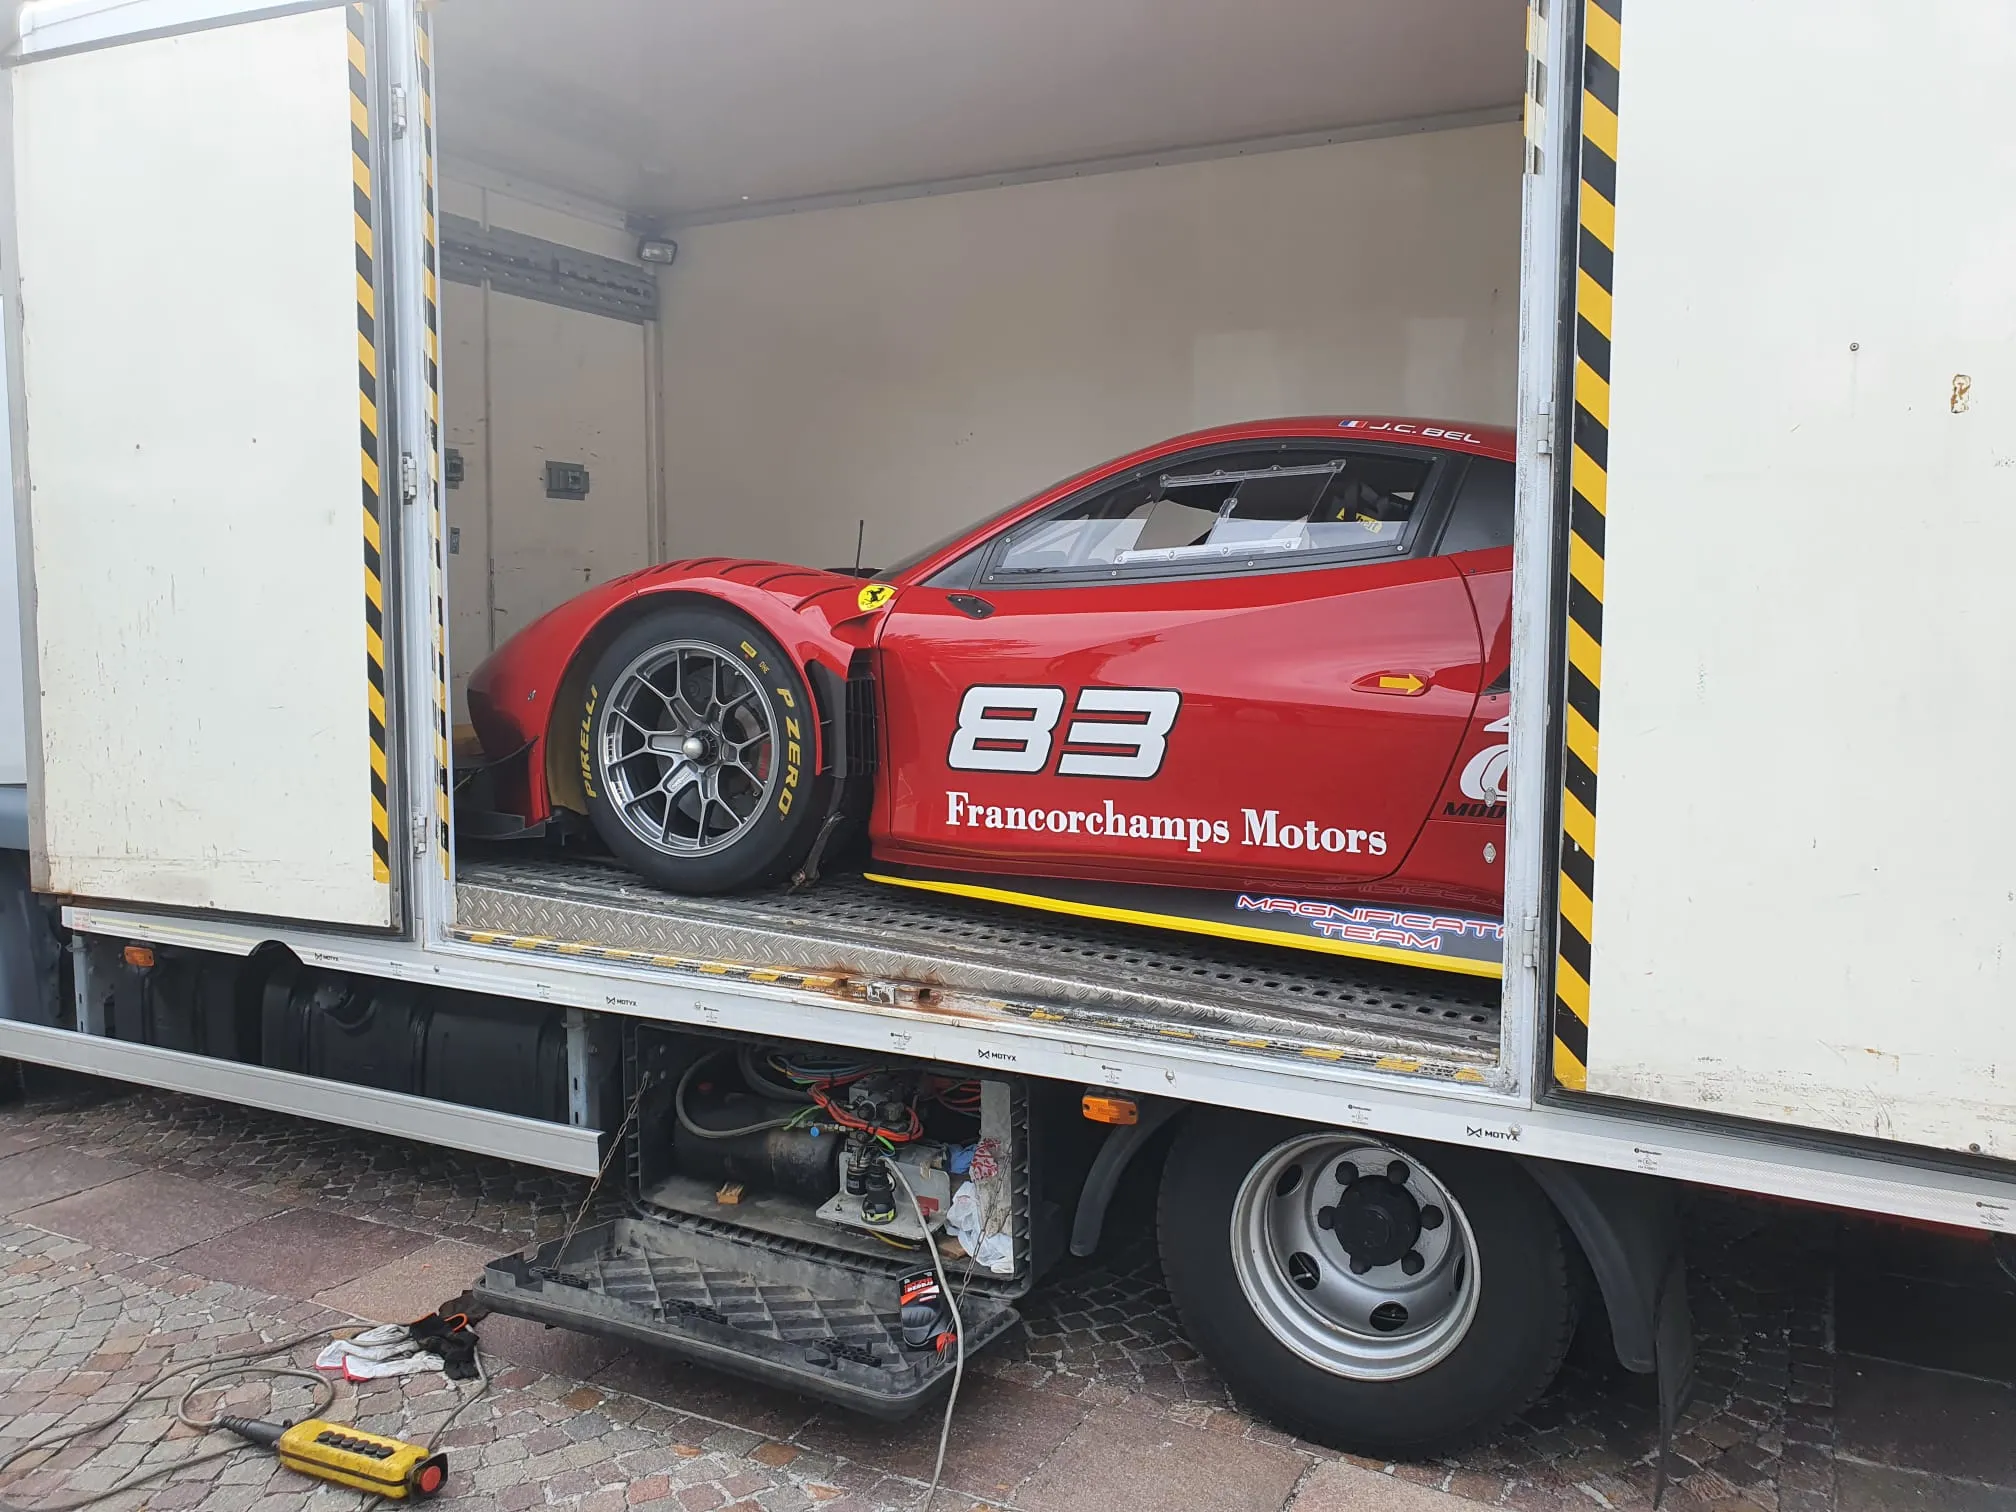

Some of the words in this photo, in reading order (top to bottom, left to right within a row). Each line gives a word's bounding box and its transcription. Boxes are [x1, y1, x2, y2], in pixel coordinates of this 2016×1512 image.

[1421, 427, 1482, 444] BEL
[776, 687, 795, 708] P
[580, 684, 599, 799] PIRELLI
[946, 683, 1183, 780] 83
[778, 716, 801, 816] ZERO
[945, 791, 1230, 852] Francorchamps
[1240, 808, 1388, 856] Motors
[1312, 919, 1442, 952] TEAM
[991, 1052, 1017, 1062] MOTYX
